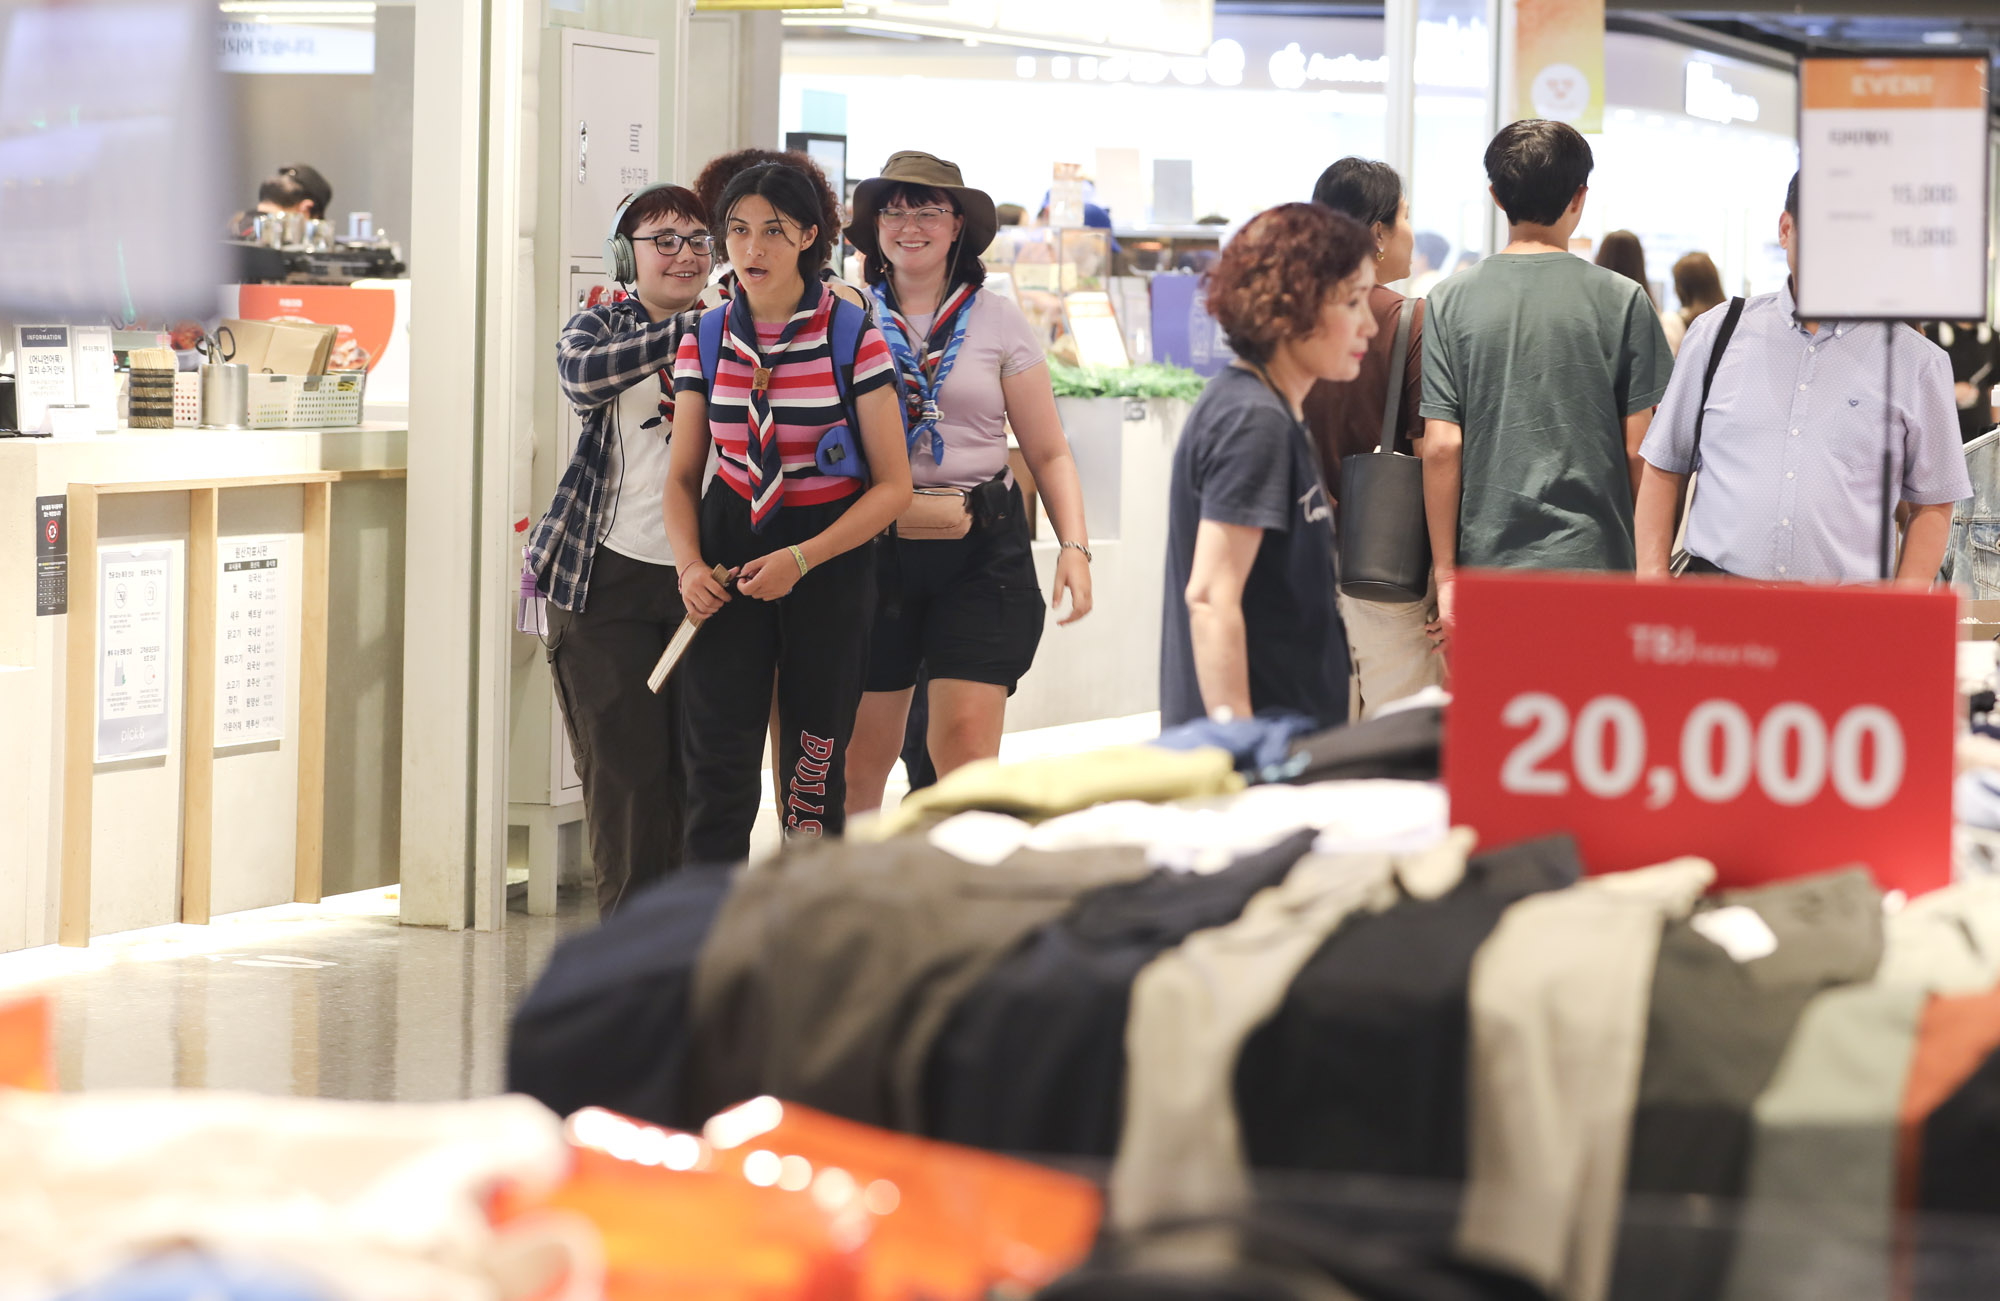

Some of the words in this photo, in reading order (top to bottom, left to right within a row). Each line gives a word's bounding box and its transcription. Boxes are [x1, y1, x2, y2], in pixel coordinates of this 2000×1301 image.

[1851, 75, 1935, 96] EVENT
[29, 354, 63, 364] (어니언어묵)
[41, 365, 53, 375] 수거
[53, 365, 65, 375] 안내
[235, 545, 268, 559] 원산지표시판
[1499, 691, 1906, 810] 20,000
